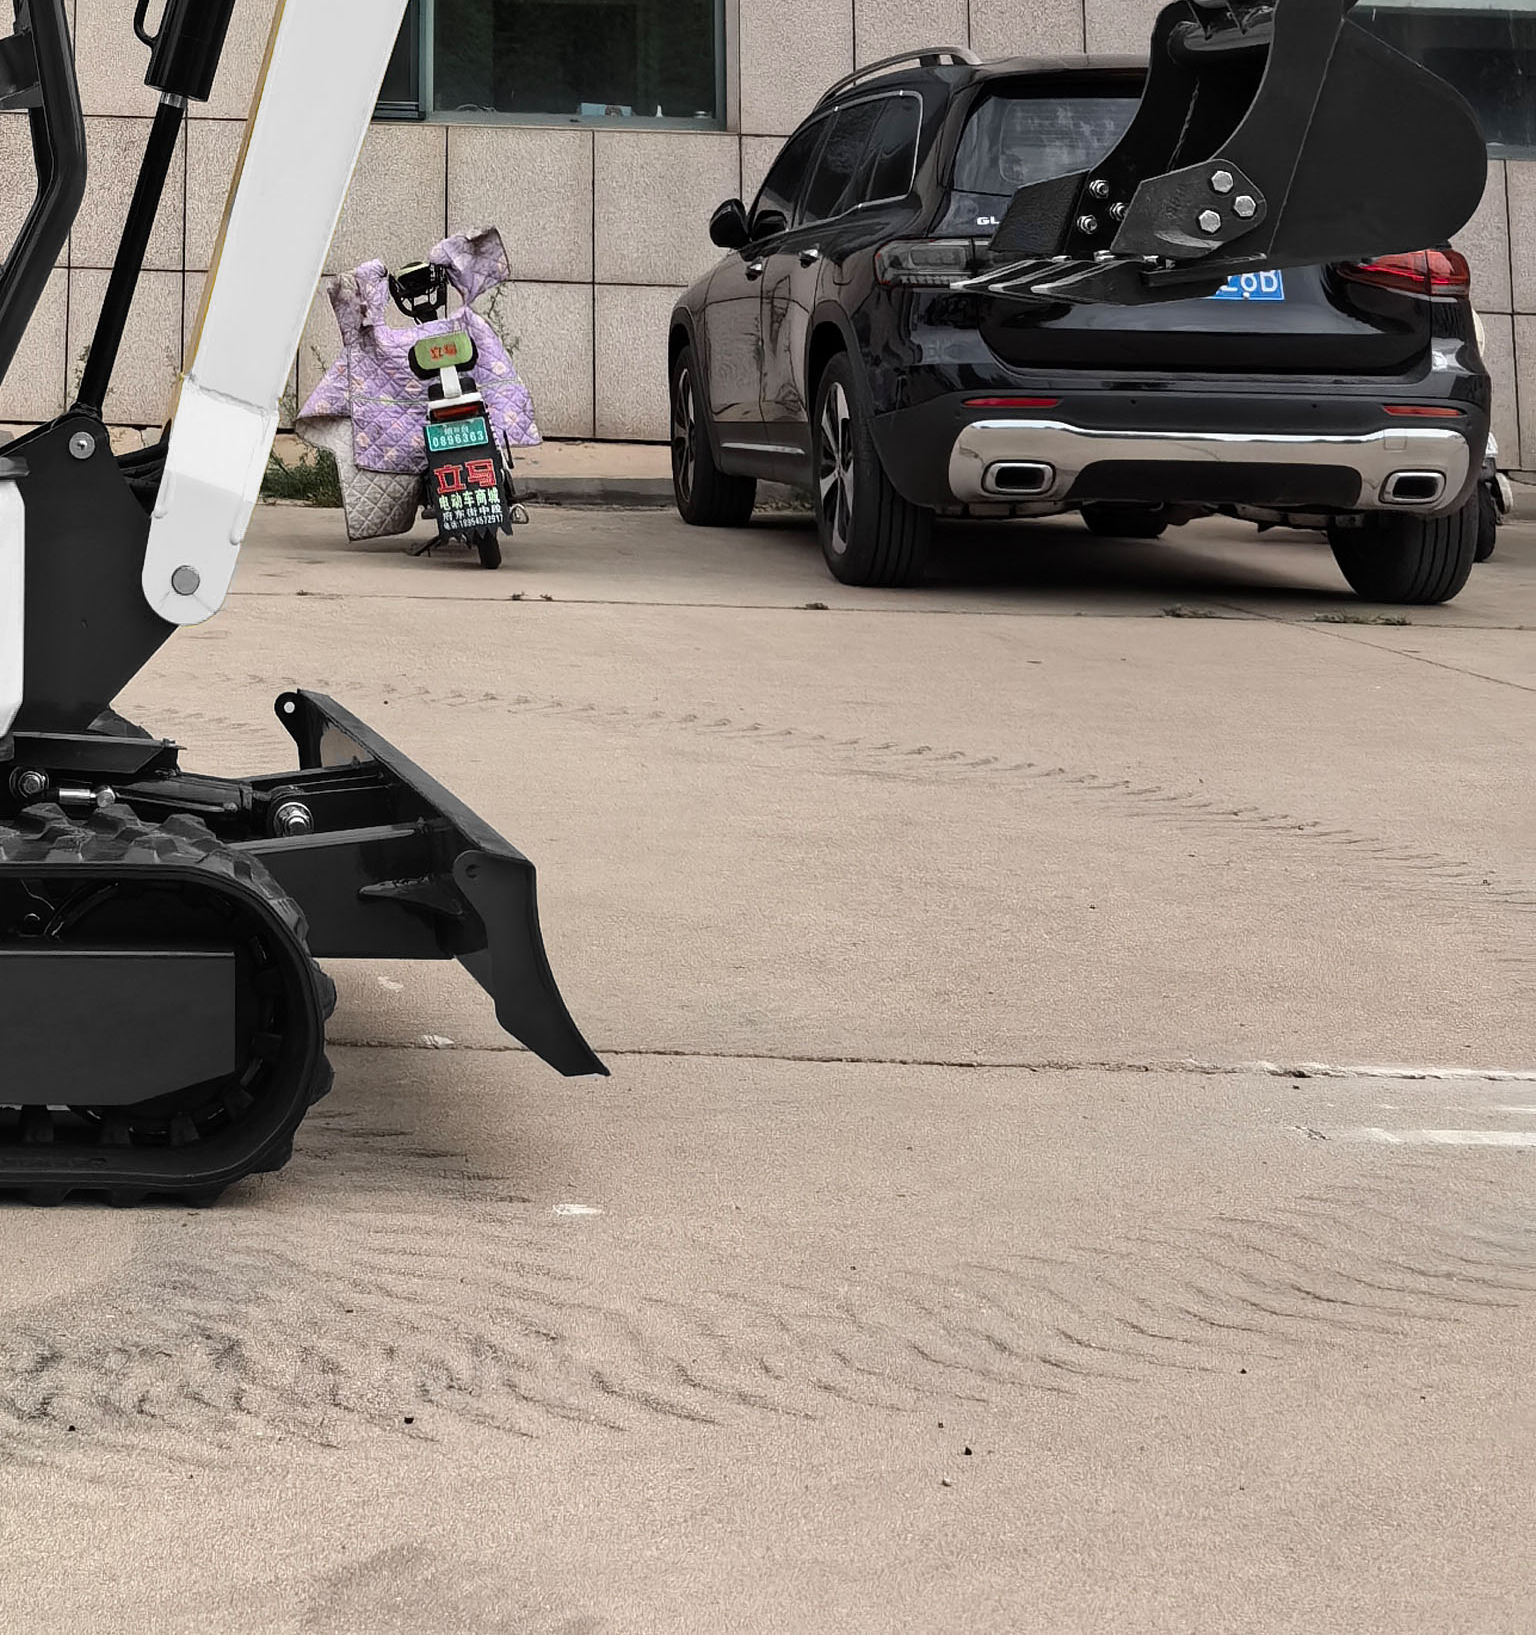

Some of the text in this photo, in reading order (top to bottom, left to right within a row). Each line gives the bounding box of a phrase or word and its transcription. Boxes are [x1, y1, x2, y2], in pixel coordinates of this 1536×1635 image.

[433, 458, 497, 494] 立马
[438, 486, 501, 511] 电动车商城
